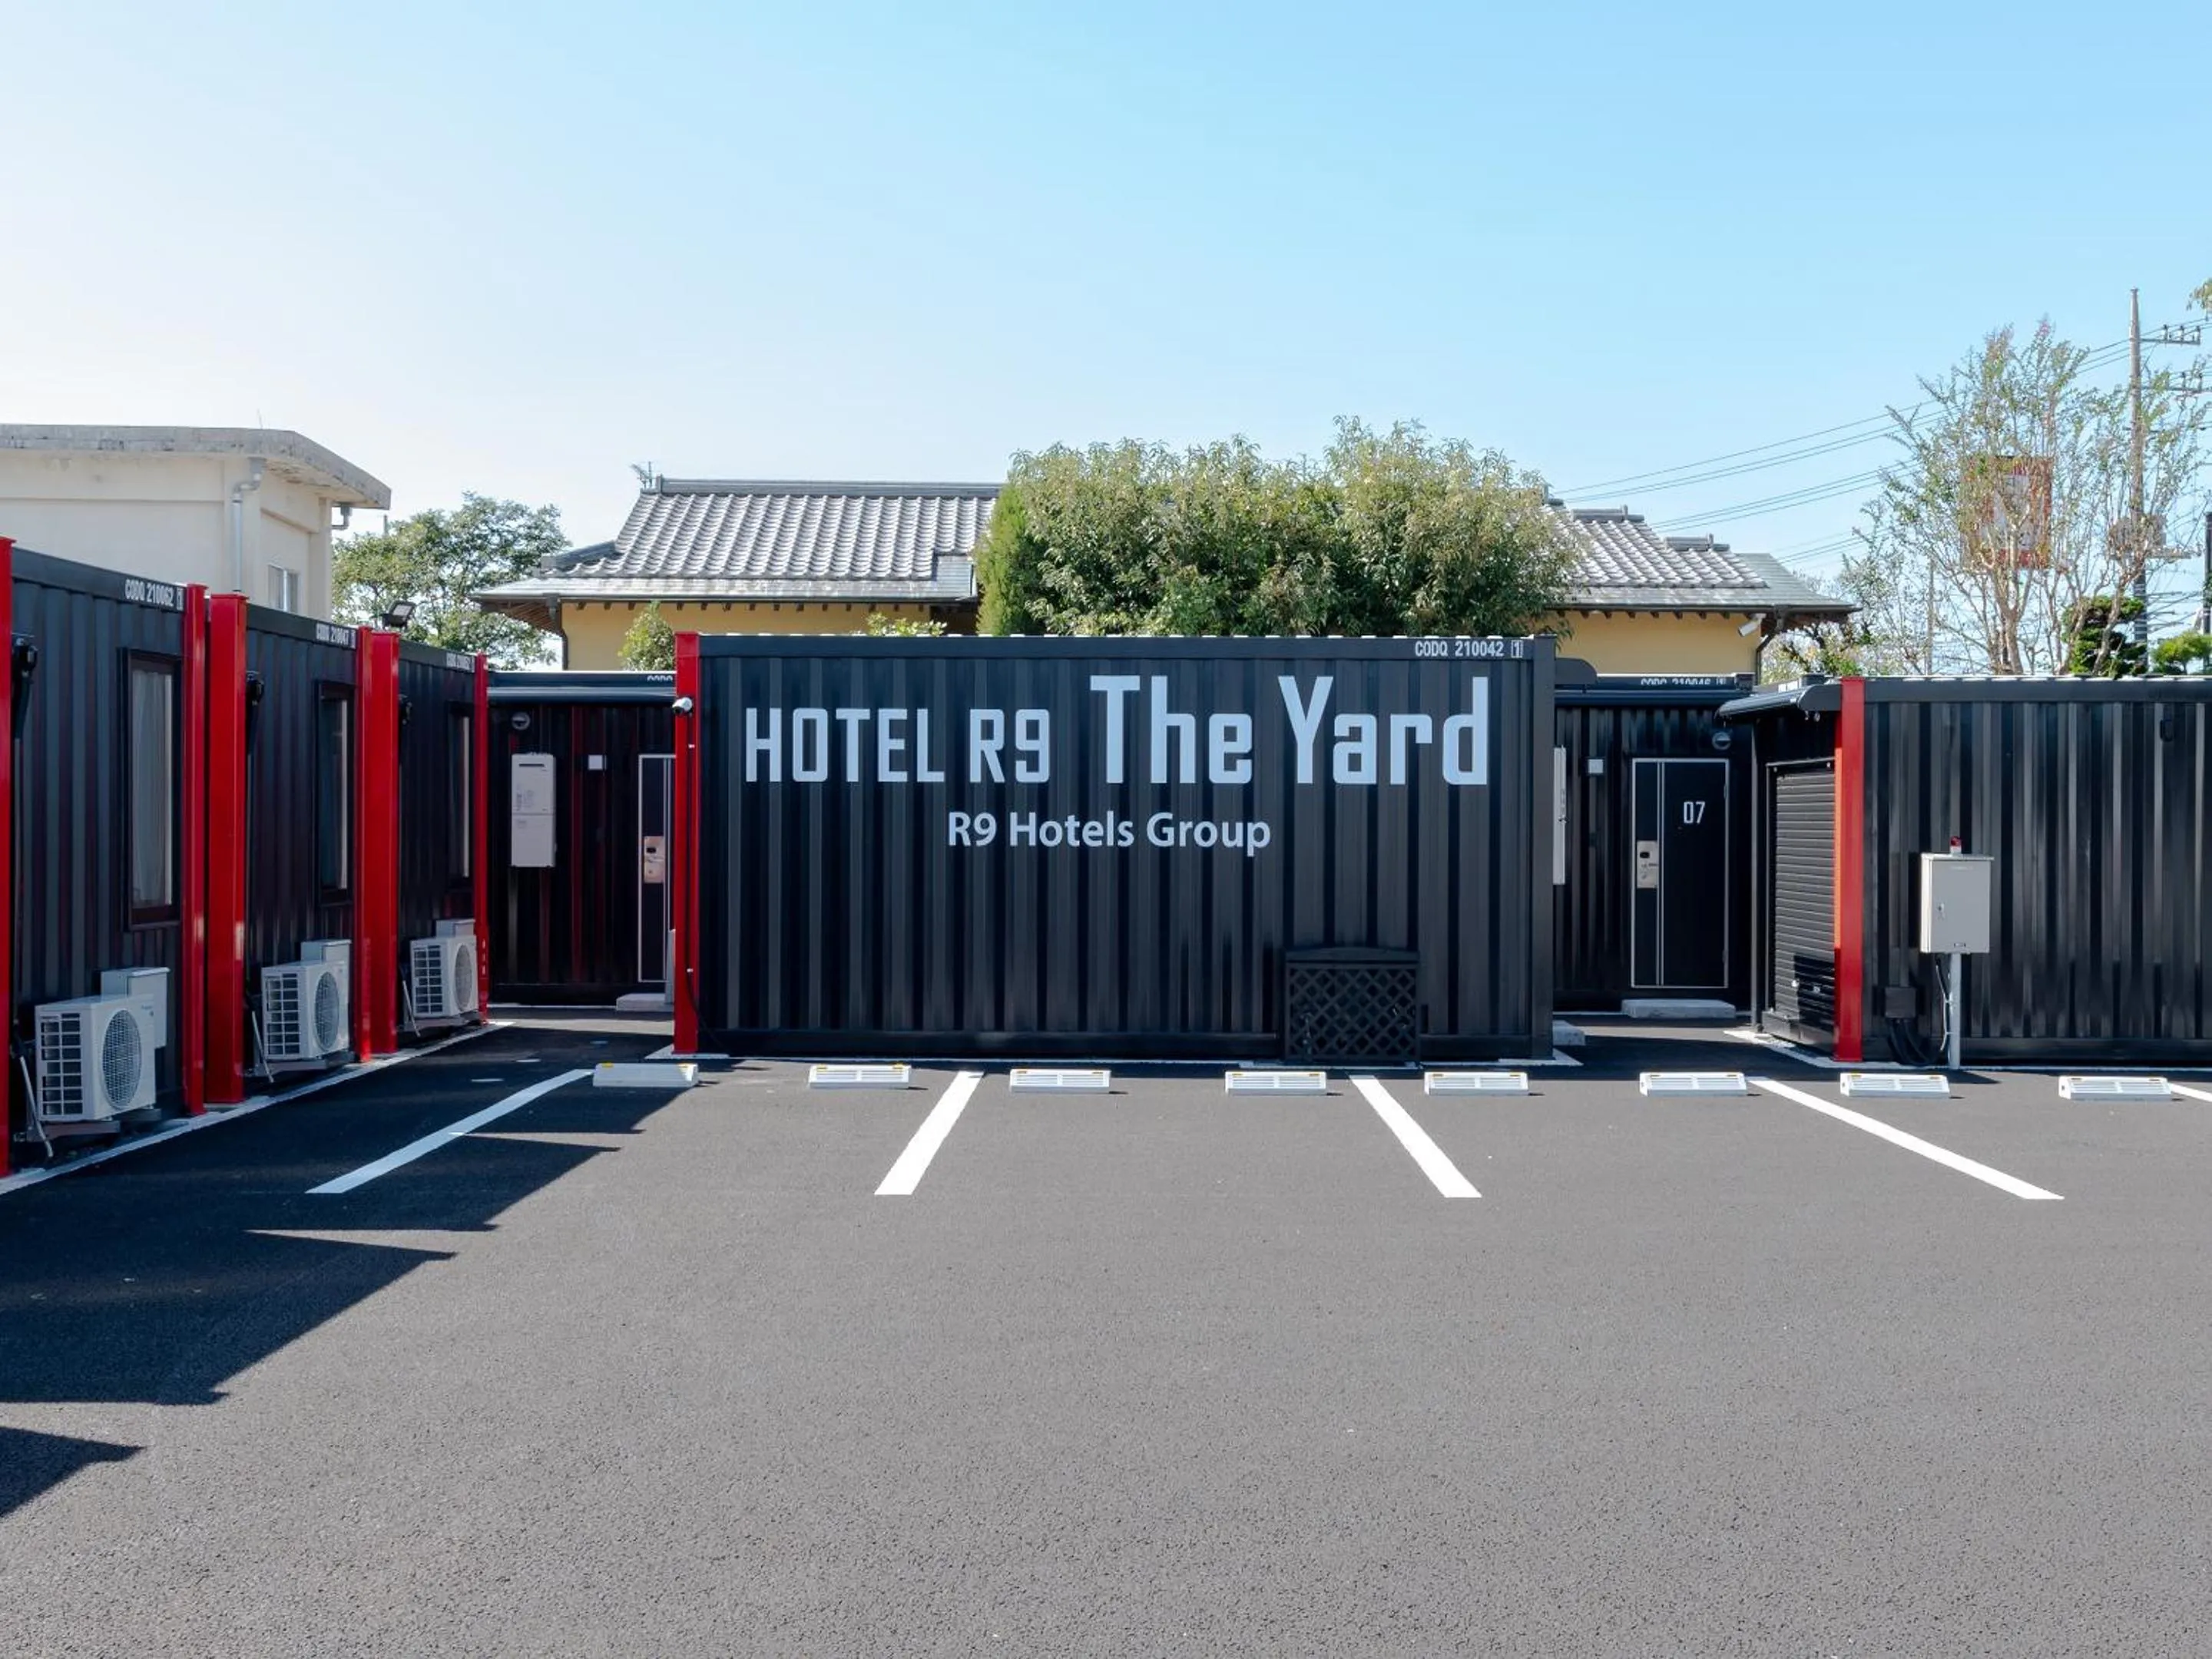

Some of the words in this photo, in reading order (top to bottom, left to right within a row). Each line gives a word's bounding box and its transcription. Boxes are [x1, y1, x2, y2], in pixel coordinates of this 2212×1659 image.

[1455, 640, 1505, 657] 210042
[745, 707, 945, 783] HOTEL
[969, 708, 1050, 783] R9
[1090, 674, 1253, 784] The
[1277, 675, 1488, 785] Yard
[1683, 801, 1706, 824] 07
[949, 812, 997, 846] R9
[1009, 810, 1134, 847] Hotels
[1146, 812, 1271, 857] Group
